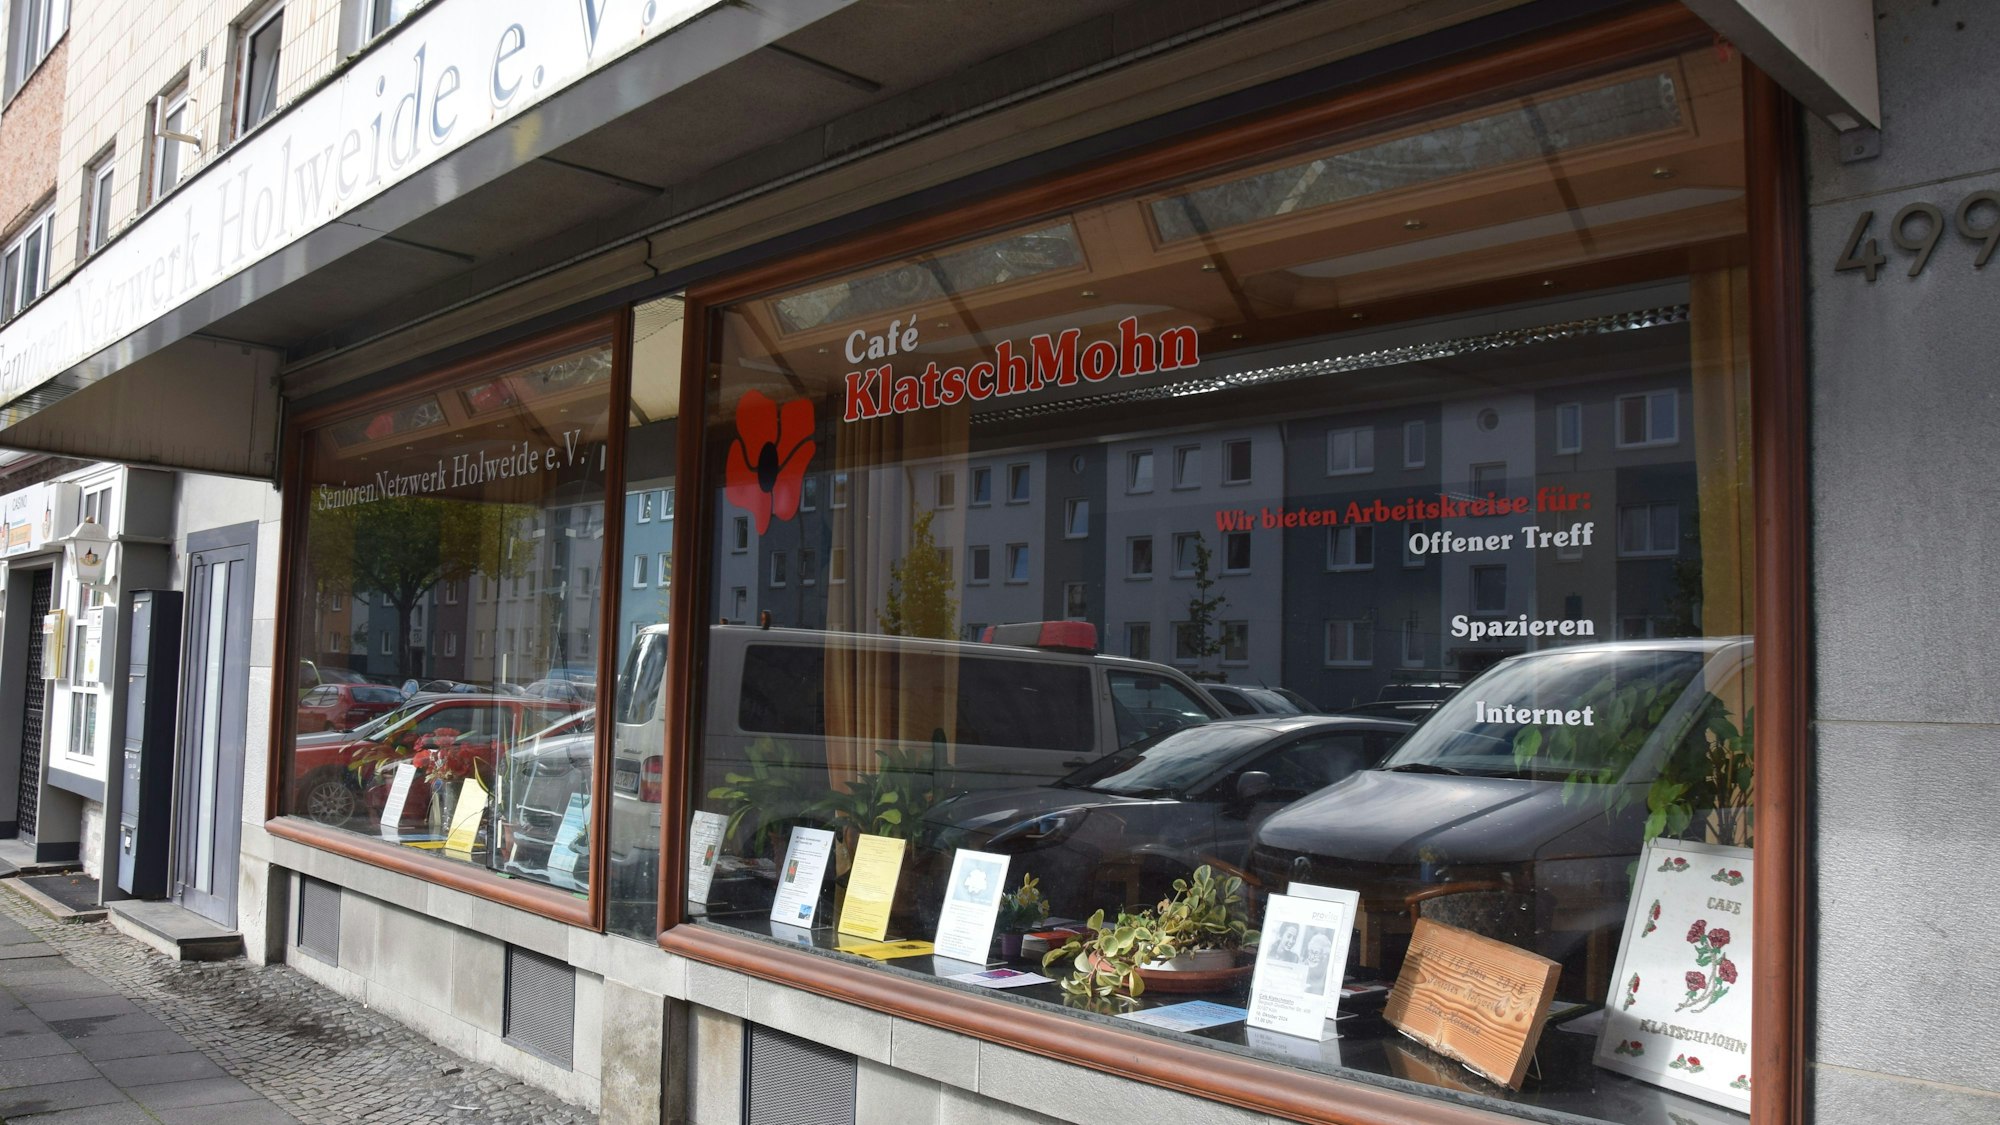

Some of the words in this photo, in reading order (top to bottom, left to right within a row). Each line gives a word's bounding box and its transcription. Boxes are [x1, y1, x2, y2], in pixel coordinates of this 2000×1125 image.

[211, 41, 461, 277] Holweide
[1835, 189, 2000, 282] 499
[844, 314, 919, 364] Café
[844, 315, 1200, 422] KlatschMohn
[318, 461, 446, 512] SeniorenNetzwerk
[451, 440, 539, 488] Holweide
[1215, 509, 1258, 532] Wir
[1261, 505, 1337, 530] bieten
[1343, 491, 1530, 525] Arbeitskreise
[1536, 486, 1592, 513] für:
[1409, 530, 1514, 555] Offener
[1521, 522, 1594, 549] Treff
[1451, 614, 1595, 642] Spazieren
[1476, 701, 1595, 726] Internet
[1311, 911, 1339, 921] provita
[1706, 896, 1742, 915] CAFE
[1639, 1018, 1748, 1055] KLATSCHMOHN
